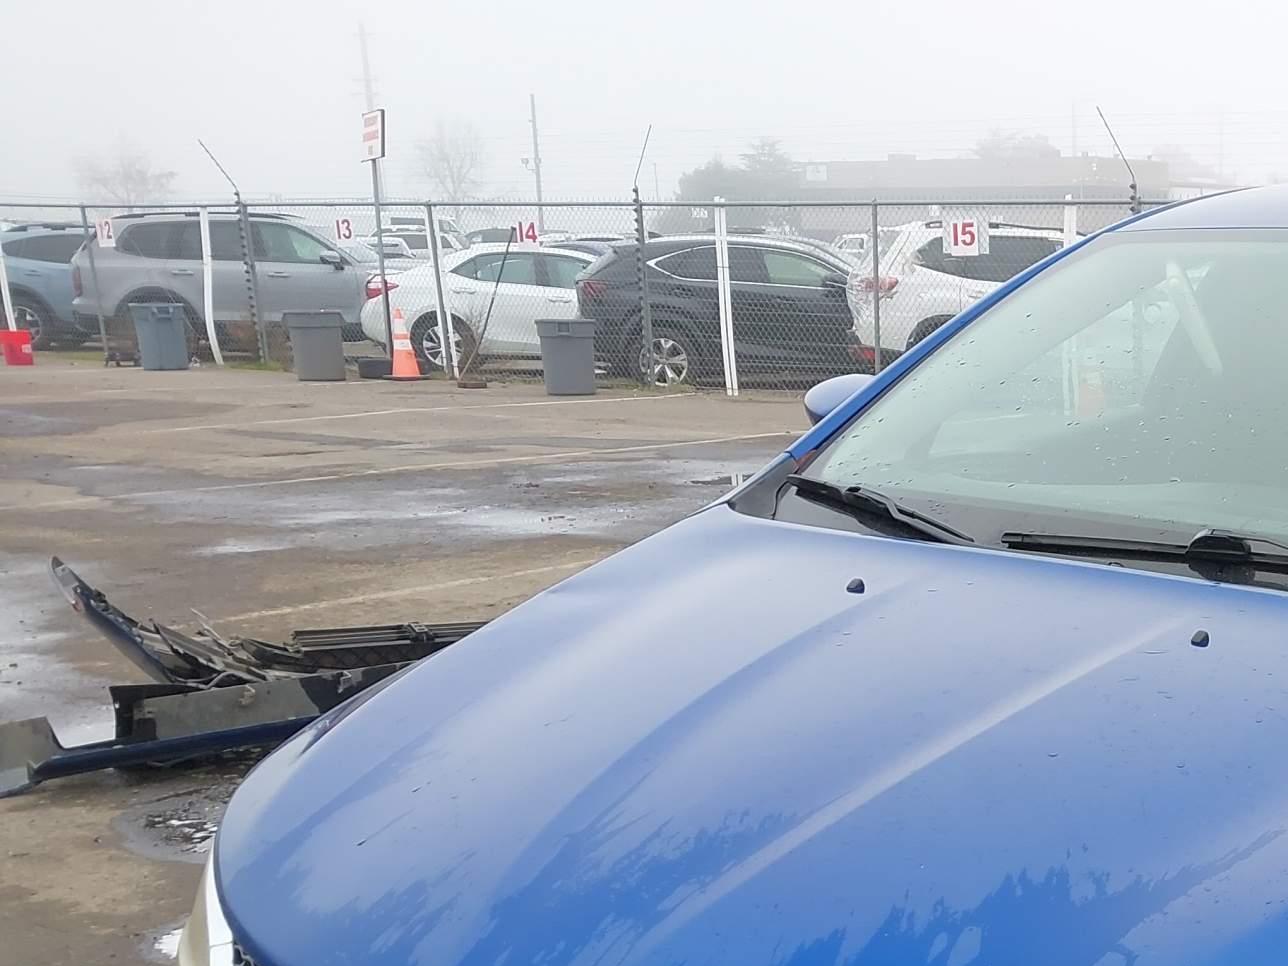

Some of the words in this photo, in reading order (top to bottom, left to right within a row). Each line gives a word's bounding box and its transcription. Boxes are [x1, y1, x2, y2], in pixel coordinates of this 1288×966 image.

[98, 220, 113, 240] 12
[335, 218, 353, 240] 13
[518, 221, 538, 243] 14
[952, 221, 976, 247] 15
